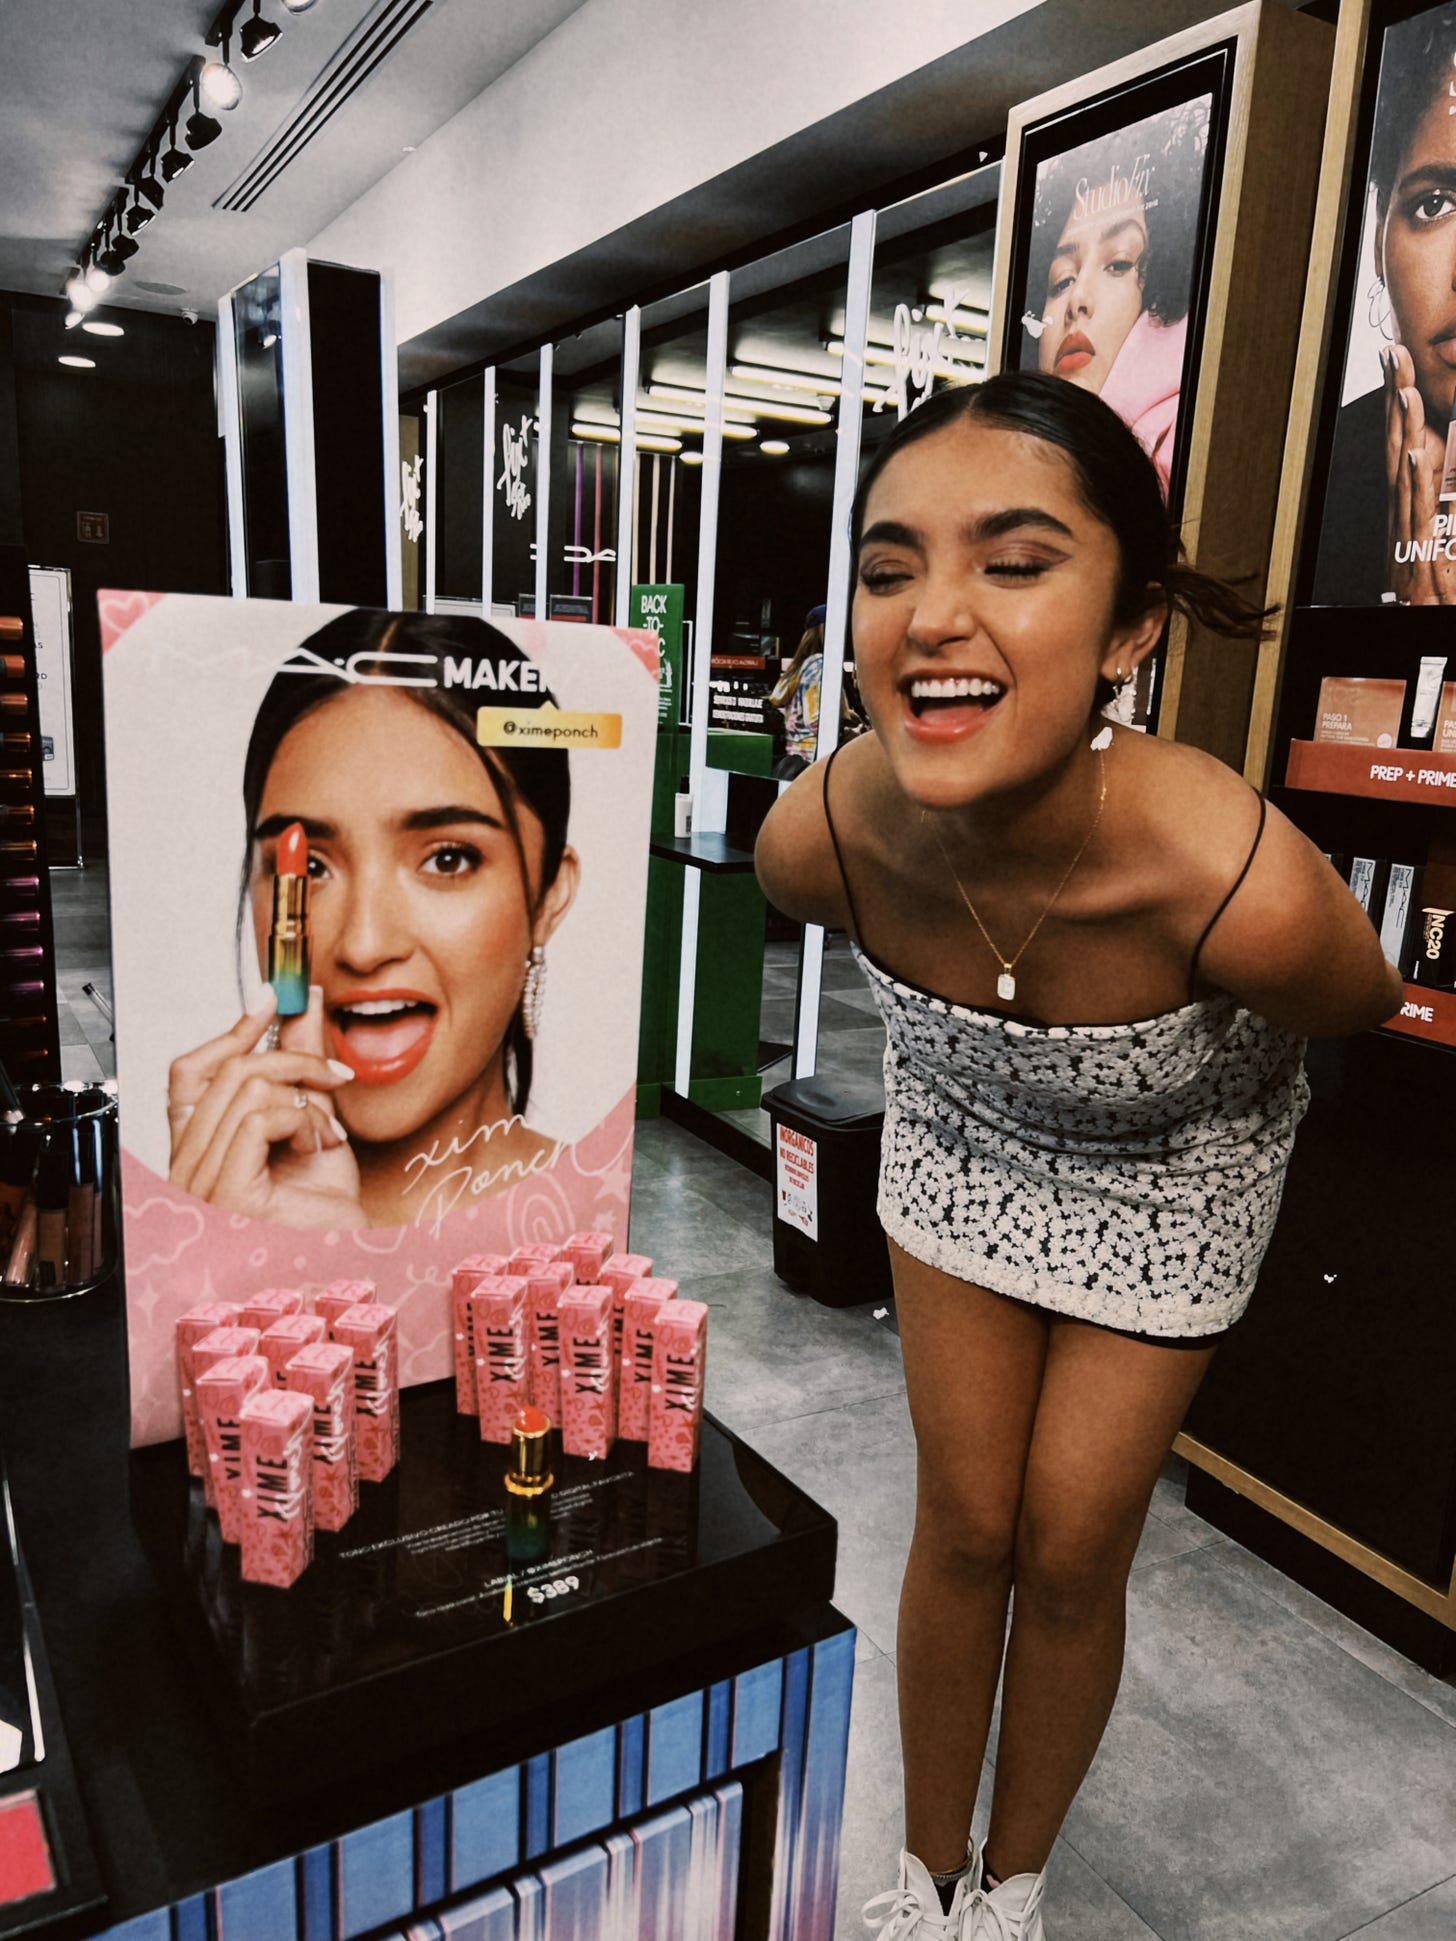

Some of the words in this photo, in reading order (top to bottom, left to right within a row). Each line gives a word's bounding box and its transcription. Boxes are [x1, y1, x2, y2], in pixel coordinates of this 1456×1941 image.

[641, 594, 667, 614] BACK
[503, 720, 599, 741] @ximeponch
[1321, 720, 1353, 731] PREPARA
[1322, 712, 1343, 722] PASO
[1370, 764, 1404, 782] PREP
[1405, 769, 1416, 782] +
[1425, 914, 1447, 960] NC20
[1400, 1001, 1435, 1023] RIME
[786, 1150, 815, 1175] RECICLABLES
[486, 1327, 518, 1384] XIME
[573, 1337, 603, 1396] XIME
[354, 1359, 379, 1419] XIME
[664, 1354, 696, 1415] XIME
[313, 1403, 334, 1466] XIME
[255, 1455, 289, 1522] XIME
[526, 1575, 580, 1604] $389
